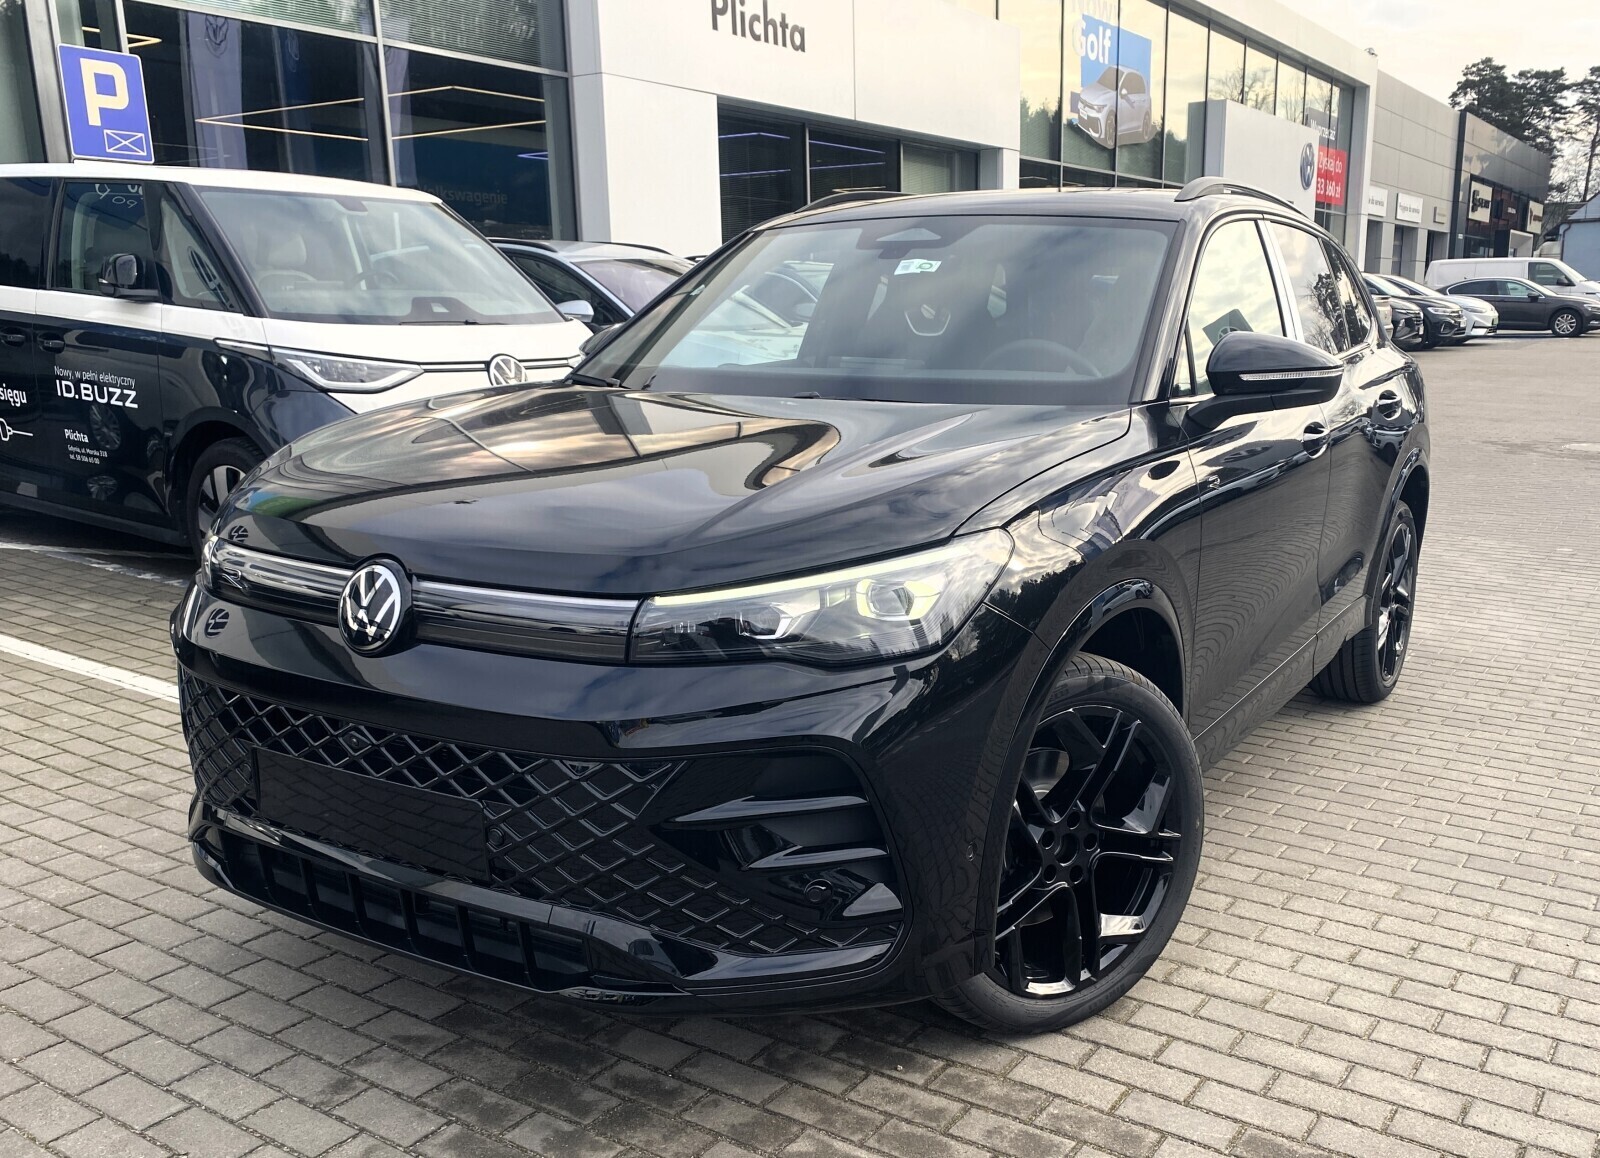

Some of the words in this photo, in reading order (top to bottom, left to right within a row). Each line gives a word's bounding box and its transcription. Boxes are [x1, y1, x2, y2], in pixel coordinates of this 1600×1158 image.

[711, 0, 806, 52] Plichta
[1072, 19, 1112, 64] Golf
[79, 57, 129, 126] P
[1335, 157, 1343, 173] do
[1316, 177, 1325, 195] 33
[54, 365, 74, 380] Nowy,
[75, 371, 81, 379] w
[82, 370, 98, 381] pełni
[99, 372, 136, 389] elektryczny
[56, 379, 138, 409] ID.BUZZ
[64, 428, 89, 443] Plichta
